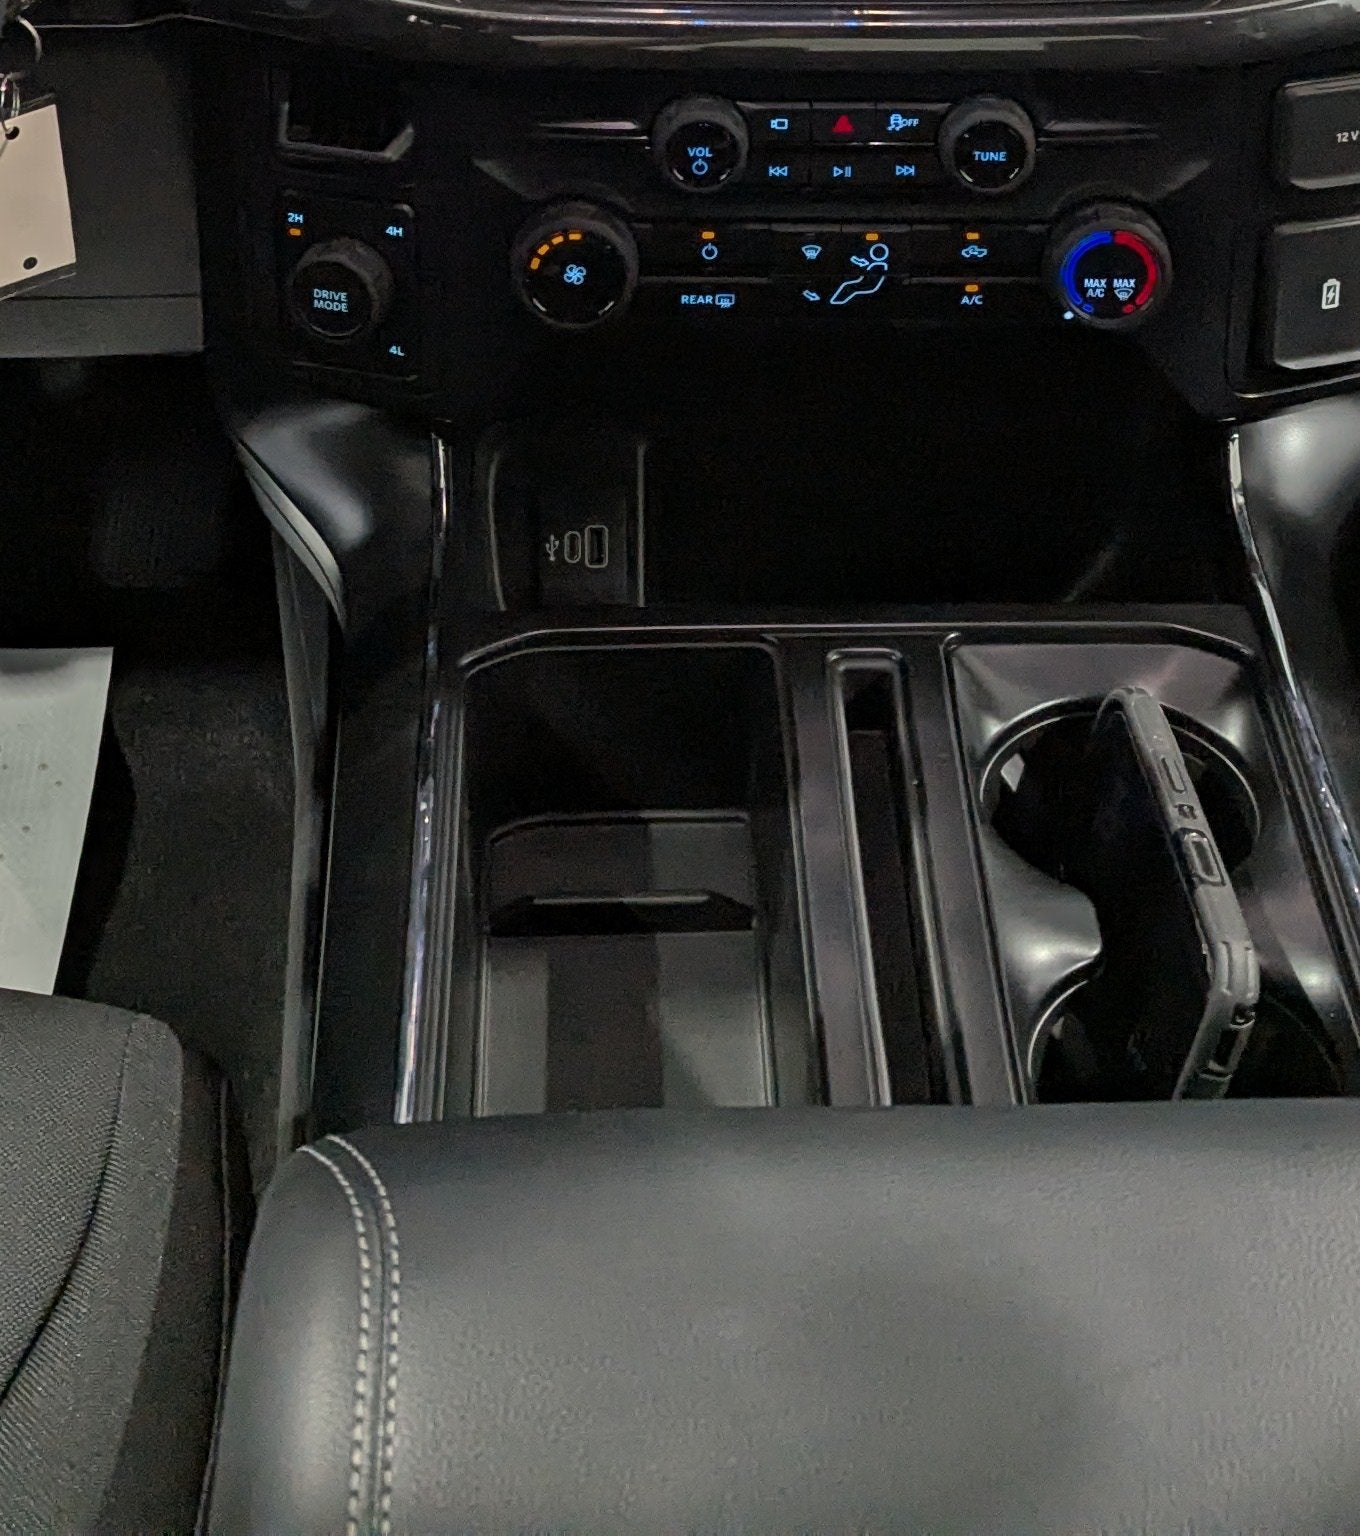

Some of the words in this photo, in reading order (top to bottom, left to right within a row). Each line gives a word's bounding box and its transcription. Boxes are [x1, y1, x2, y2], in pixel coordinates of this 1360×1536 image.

[901, 118, 919, 128] OFF
[1336, 131, 1350, 144] 12
[1350, 130, 1360, 142] V
[687, 147, 713, 158] VOL
[974, 151, 1007, 162] TUNE
[288, 212, 304, 224] 2H
[385, 226, 403, 237] 4H
[1083, 278, 1107, 289] MAX
[1113, 278, 1136, 289] MAX
[313, 288, 348, 302] DRIVE
[1086, 288, 1105, 298] A/C
[681, 295, 714, 305] REAR
[960, 294, 984, 306] A/C
[313, 299, 349, 313] MODE
[389, 345, 405, 356] 4L
